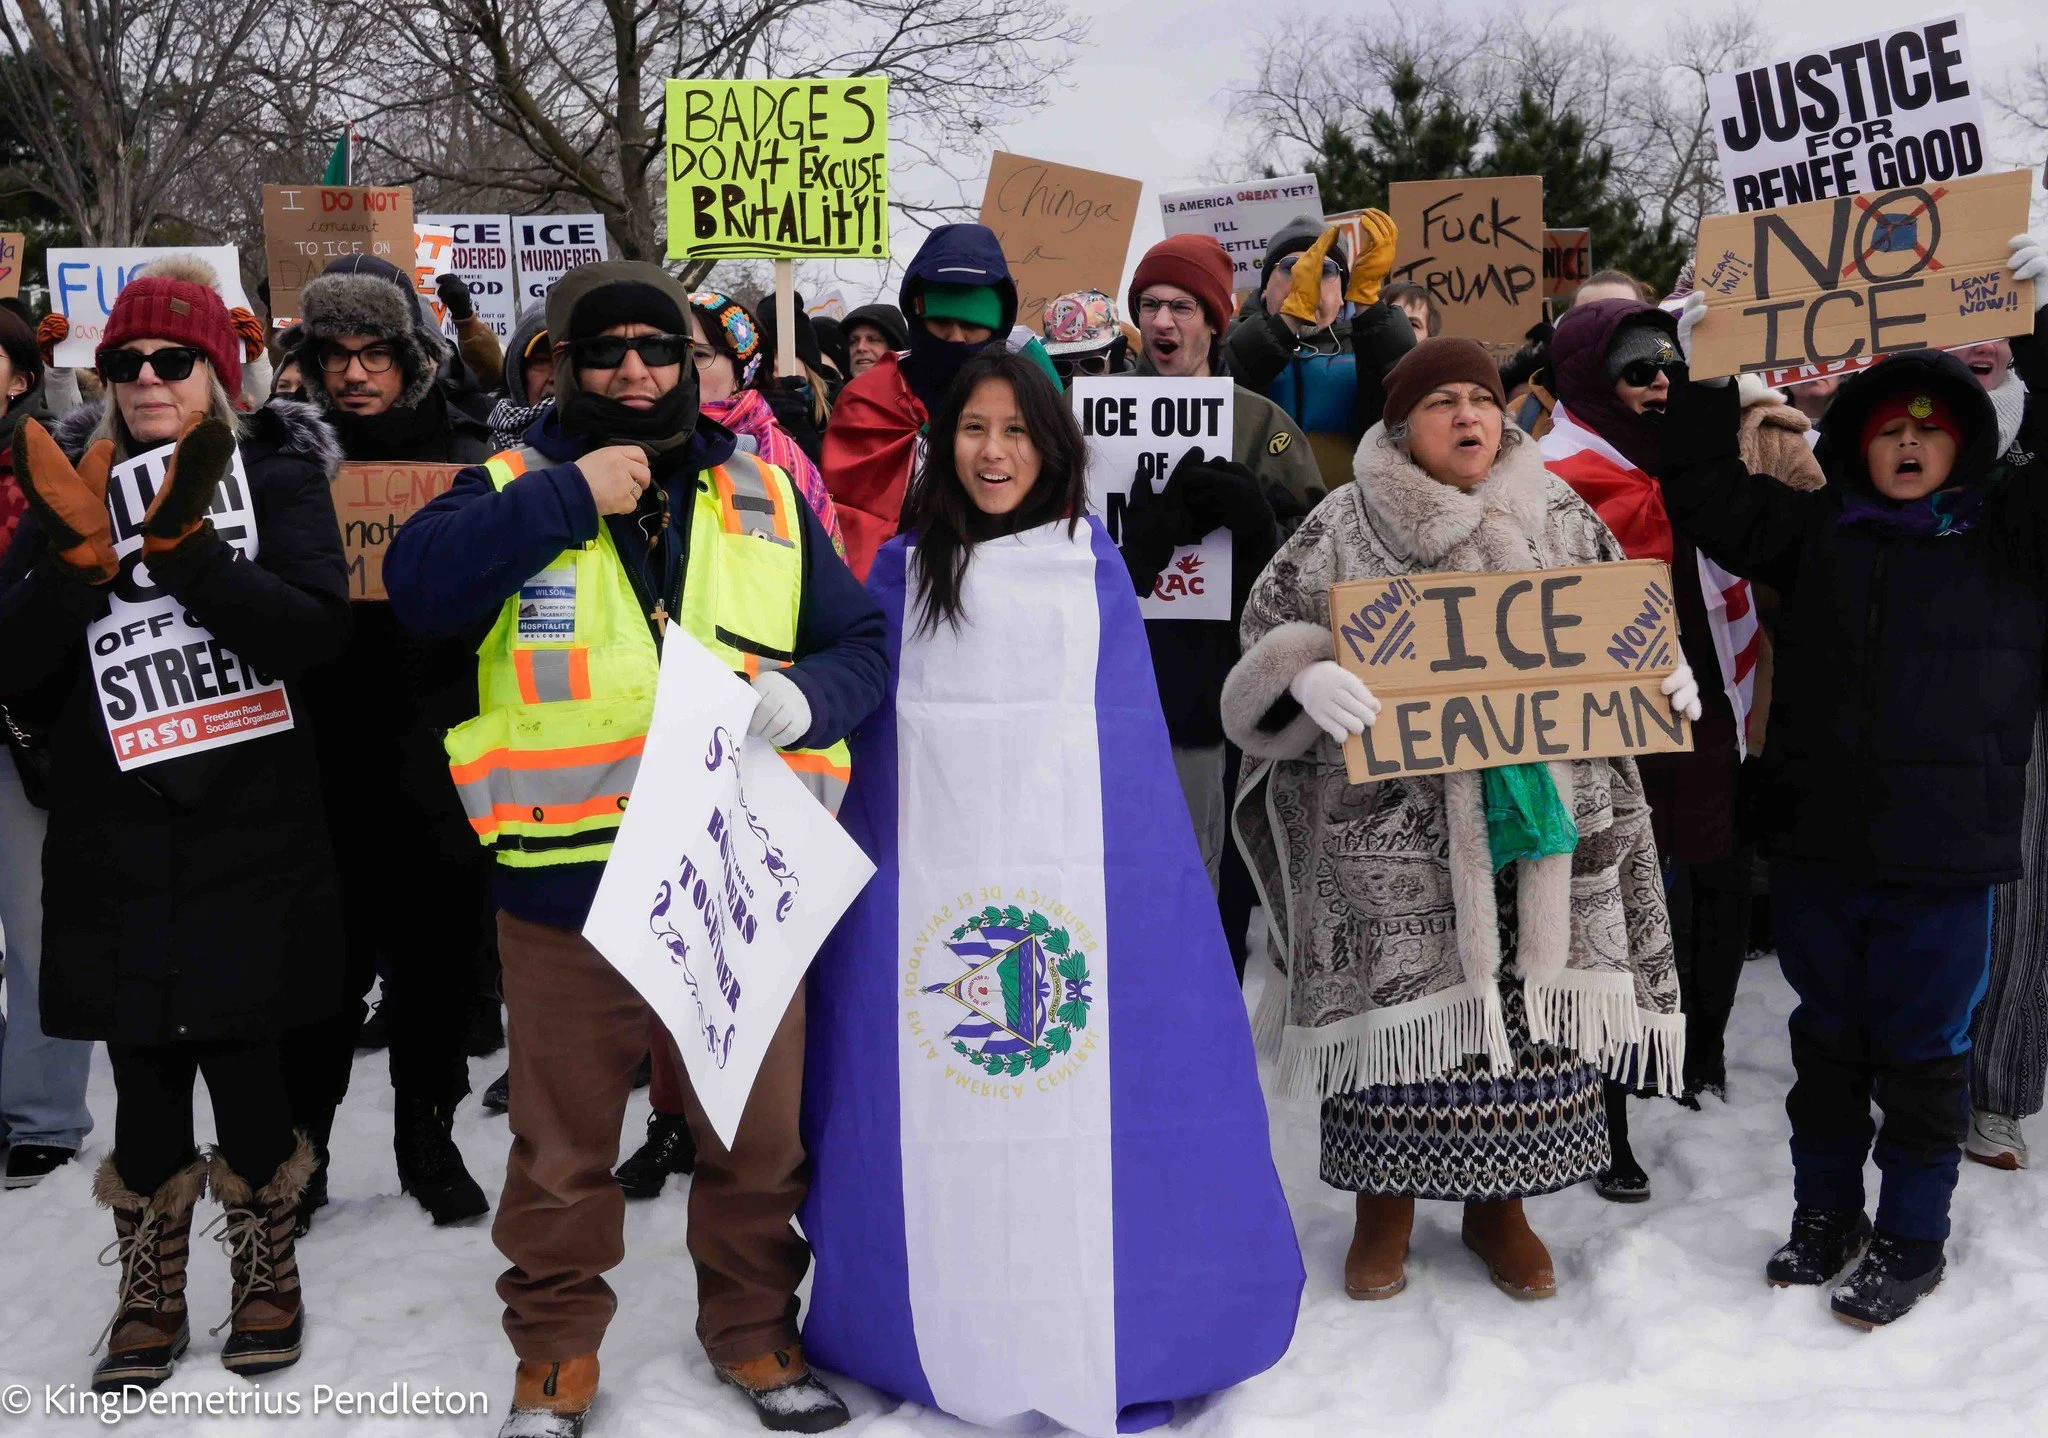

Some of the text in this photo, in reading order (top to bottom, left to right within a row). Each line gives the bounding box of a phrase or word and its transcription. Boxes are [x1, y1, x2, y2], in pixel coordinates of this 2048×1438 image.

[1721, 20, 1970, 152] JUSTICE
[686, 86, 874, 146] BADGES
[1806, 119, 1894, 156] FOR
[800, 145, 885, 197] EXCUSE
[1733, 122, 1983, 213] RENEE GOOD
[281, 191, 400, 212] I DO NOT
[998, 165, 1119, 233] Chinga
[1164, 185, 1314, 213] IS AMERICA GREAT YET?
[307, 222, 379, 232] consent
[522, 224, 595, 245] ICE
[1214, 221, 1238, 232] I'LL
[1221, 238, 1268, 252] SETTLE
[1753, 187, 1941, 300] NO
[295, 241, 391, 256] TO ICE ON
[521, 248, 602, 271] MURDERED
[1393, 256, 1536, 305] TRUMP
[1701, 250, 1735, 288] LEAVE
[1950, 272, 2000, 292] LEAVE
[1960, 291, 2018, 316] NOW!!
[1965, 283, 1998, 303] MN
[1740, 279, 1928, 372] ICE
[1082, 397, 1224, 437] ICE OUT
[1138, 452, 1168, 480] OF
[94, 612, 173, 656] OFF
[521, 622, 571, 630] HOSPITALITY
[1340, 576, 1674, 672] NOW!! ICE NOW!!
[118, 703, 262, 755] FRSO Freedom Road
[206, 708, 286, 734] Socialist Organization
[1362, 686, 1683, 776] LEAVE MN
